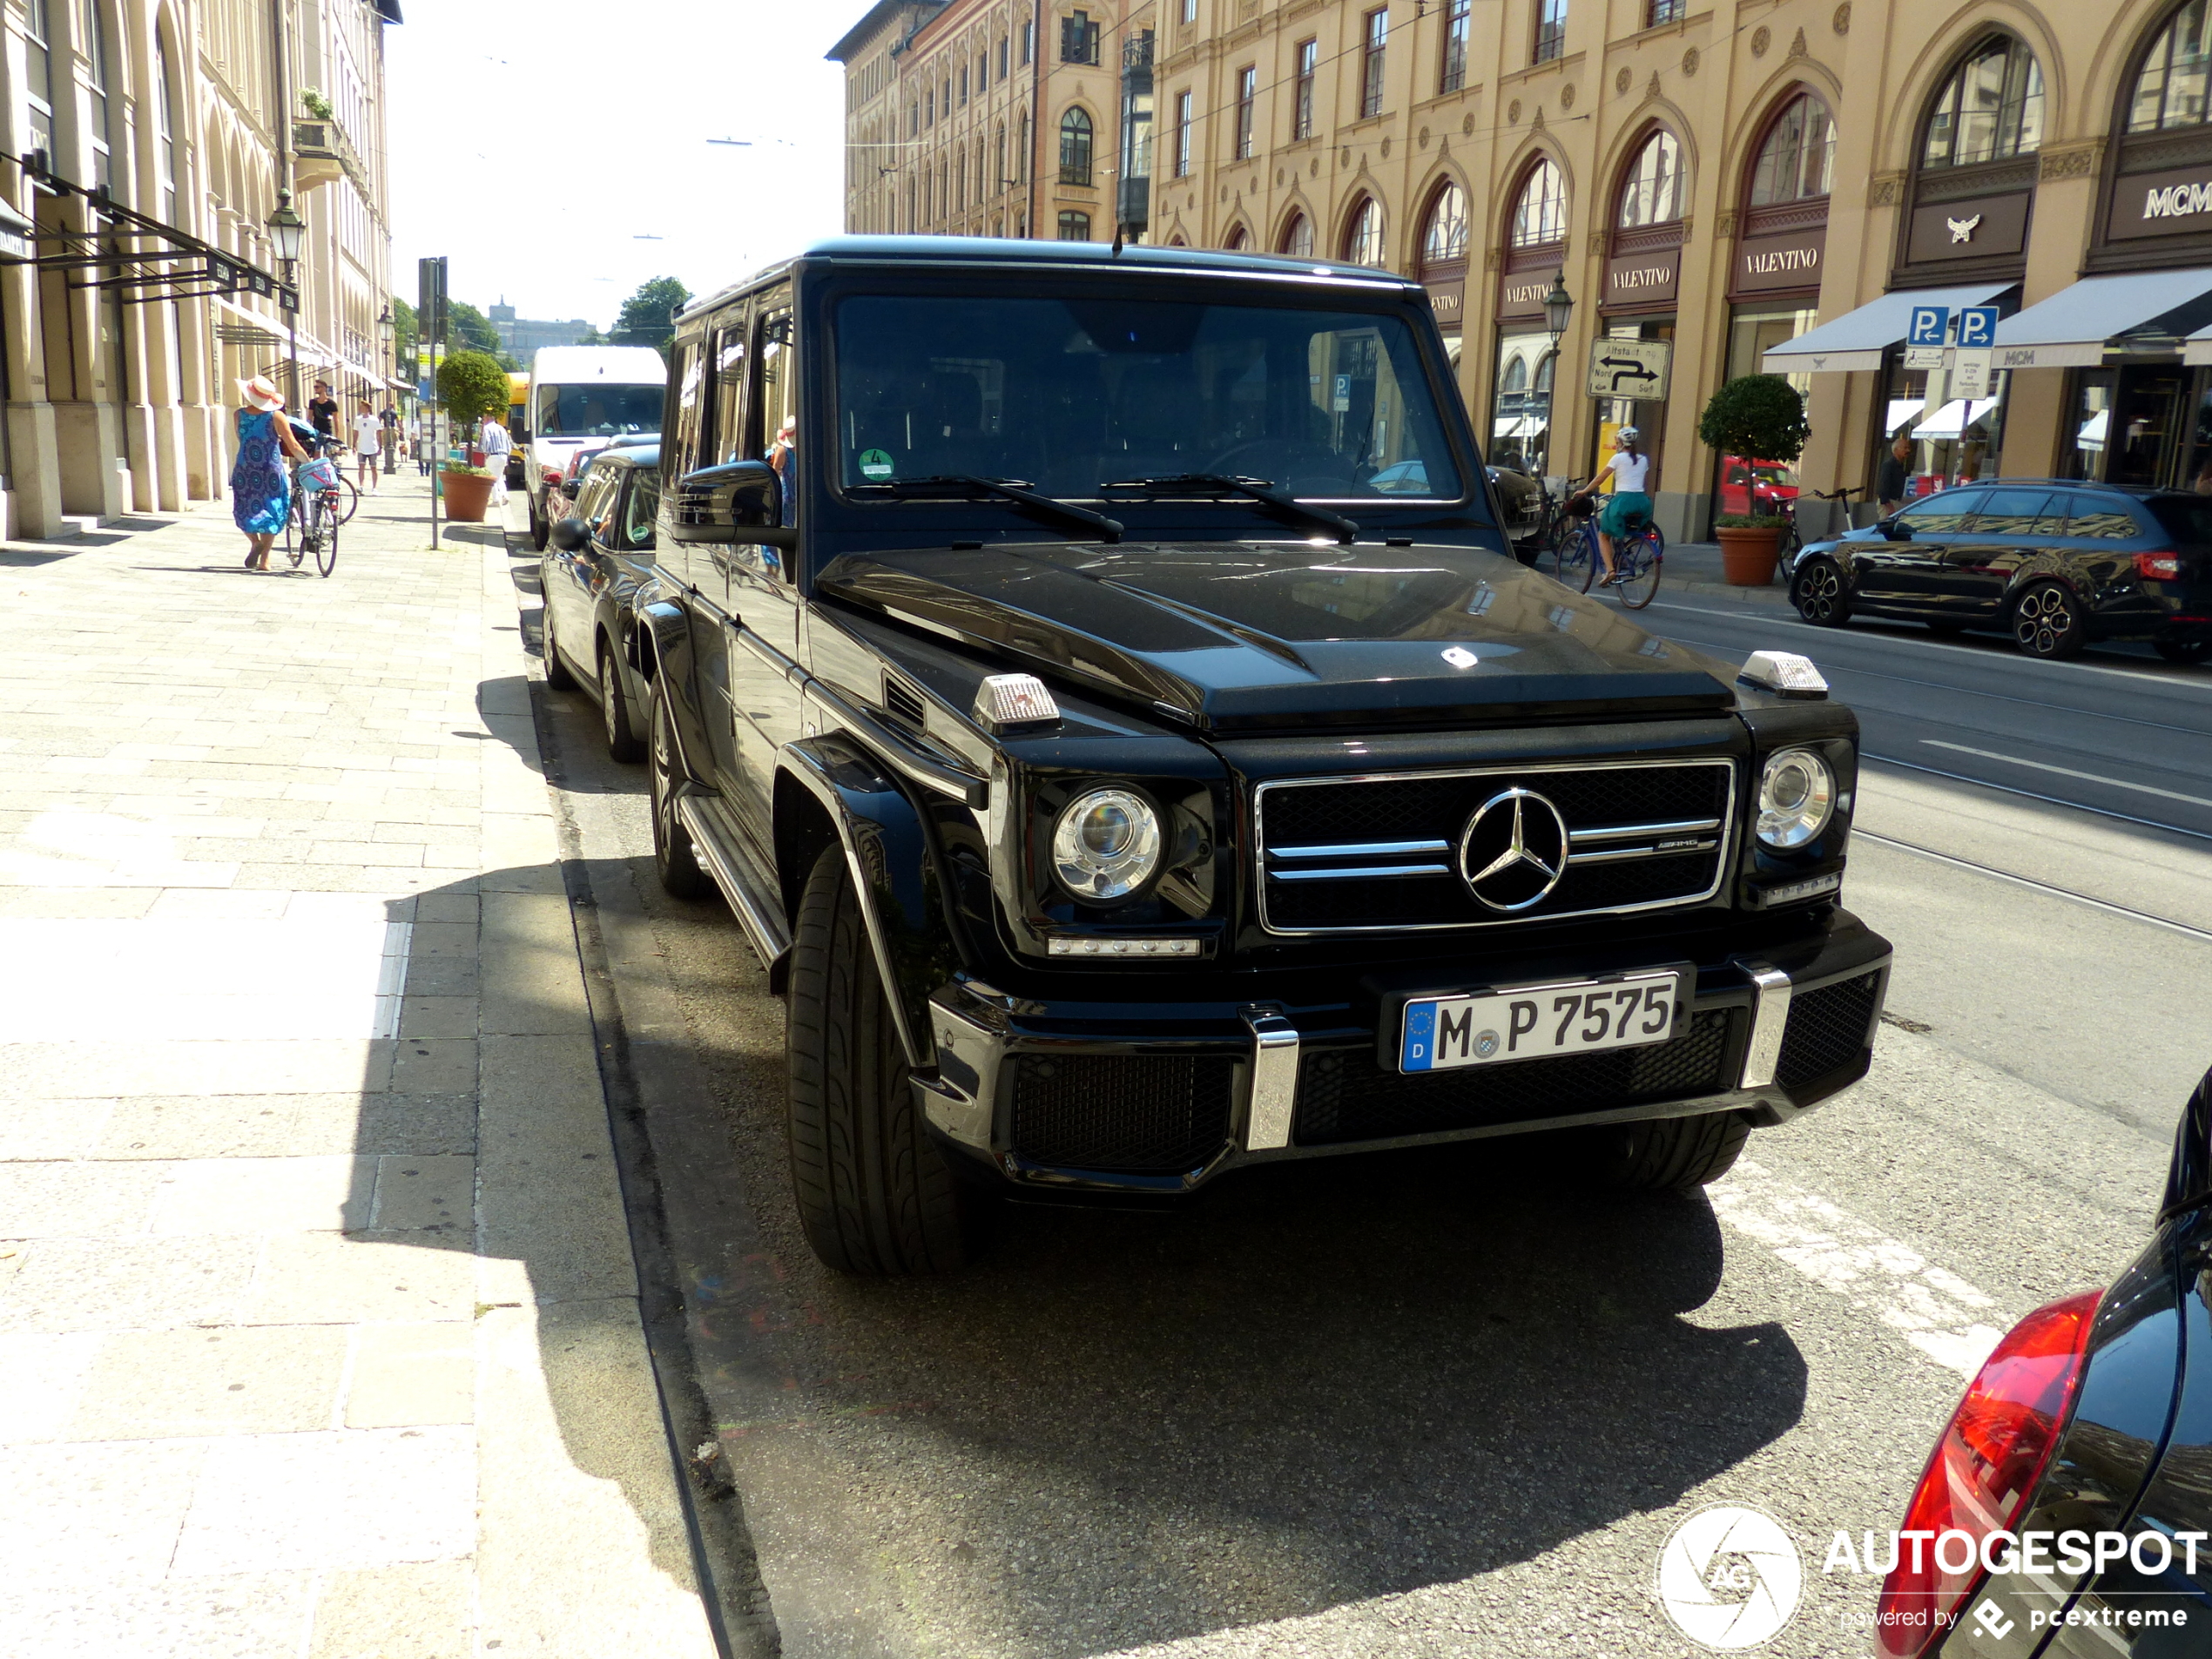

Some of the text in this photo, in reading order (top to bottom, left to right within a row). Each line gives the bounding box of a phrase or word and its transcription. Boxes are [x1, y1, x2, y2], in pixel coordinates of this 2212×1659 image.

[2142, 182, 2212, 219] MCM
[1747, 247, 1817, 273] VALENTINO
[1613, 266, 1670, 289] VALENTINO
[1431, 294, 1459, 311] ENTINO
[1914, 311, 1937, 341] P
[1963, 313, 1986, 343] P
[2004, 350, 2035, 365] MCM
[871, 450, 881, 465] 4
[1438, 1007, 1472, 1059] M
[1508, 1001, 1537, 1051] P
[1554, 984, 1671, 1045] 7575
[1413, 1043, 1424, 1058] D
